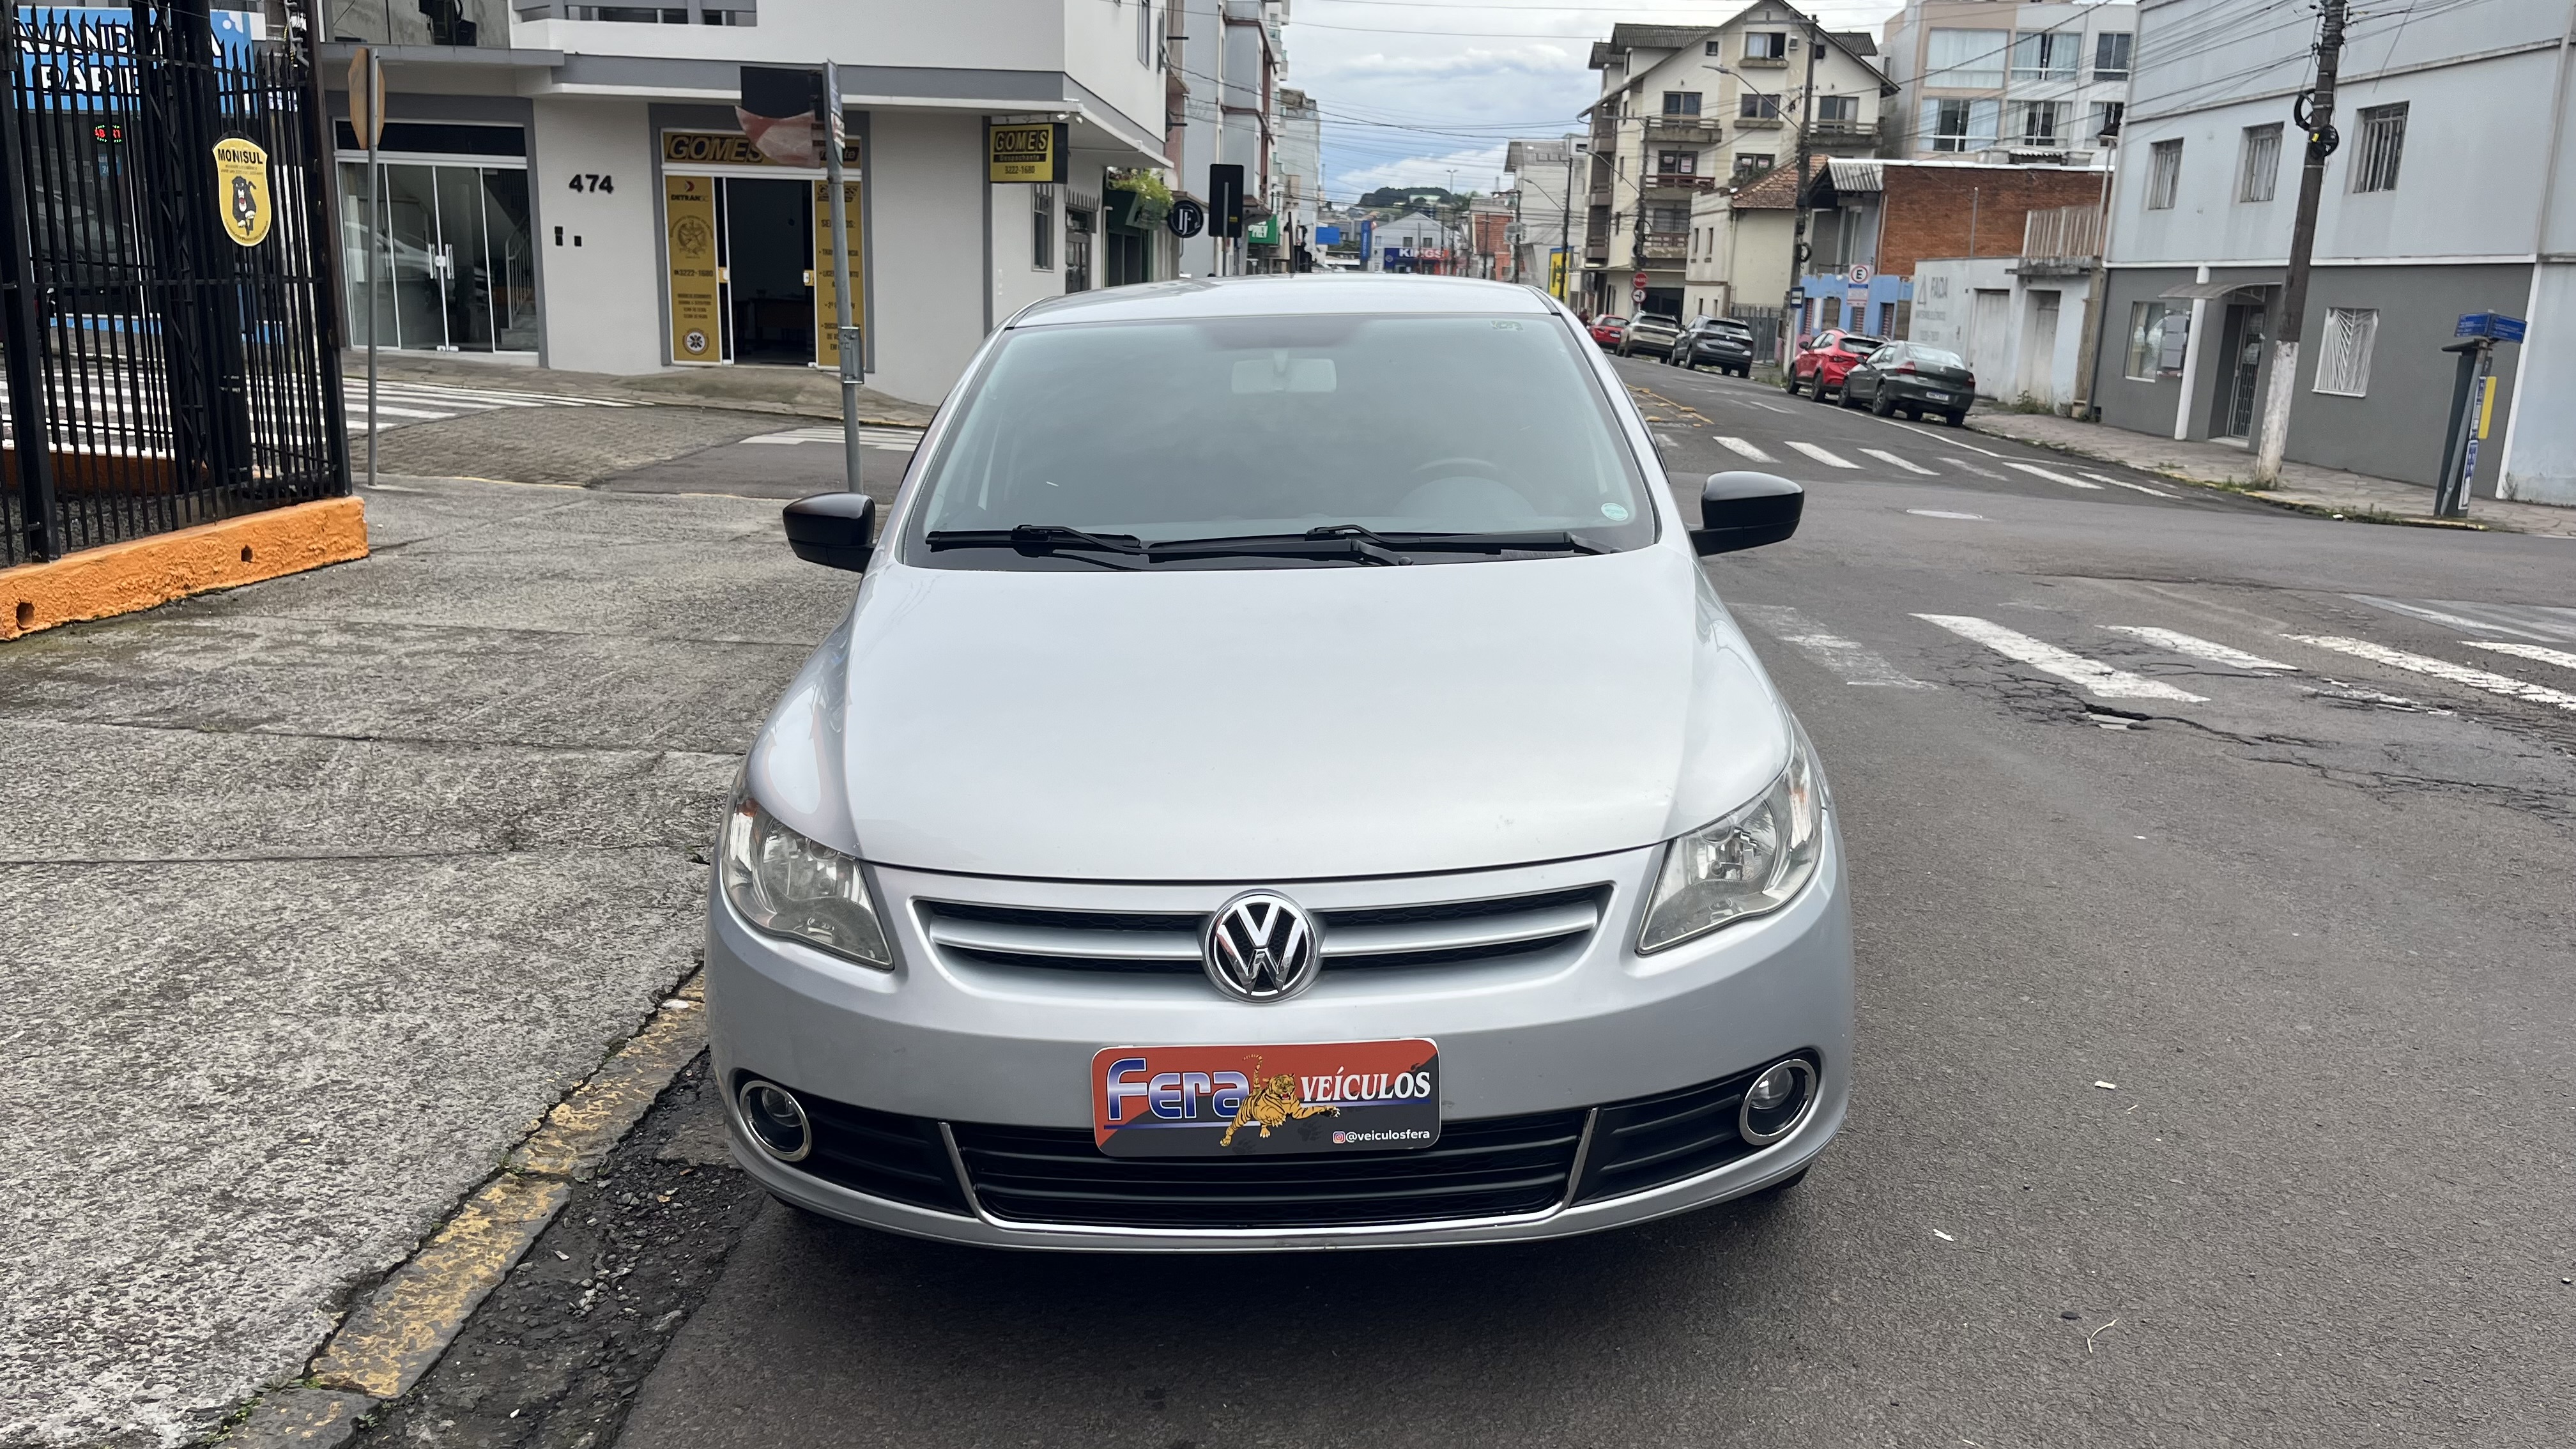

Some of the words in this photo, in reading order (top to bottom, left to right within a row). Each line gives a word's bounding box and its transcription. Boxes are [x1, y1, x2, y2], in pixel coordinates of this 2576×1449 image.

[994, 130, 1048, 151] GOMES
[217, 148, 263, 164] MONISUL
[568, 173, 615, 194] 474
[1856, 269, 1863, 280] E
[1300, 1066, 1432, 1103] VEÍCULOS
[1345, 1127, 1431, 1144] @veiculosfera
